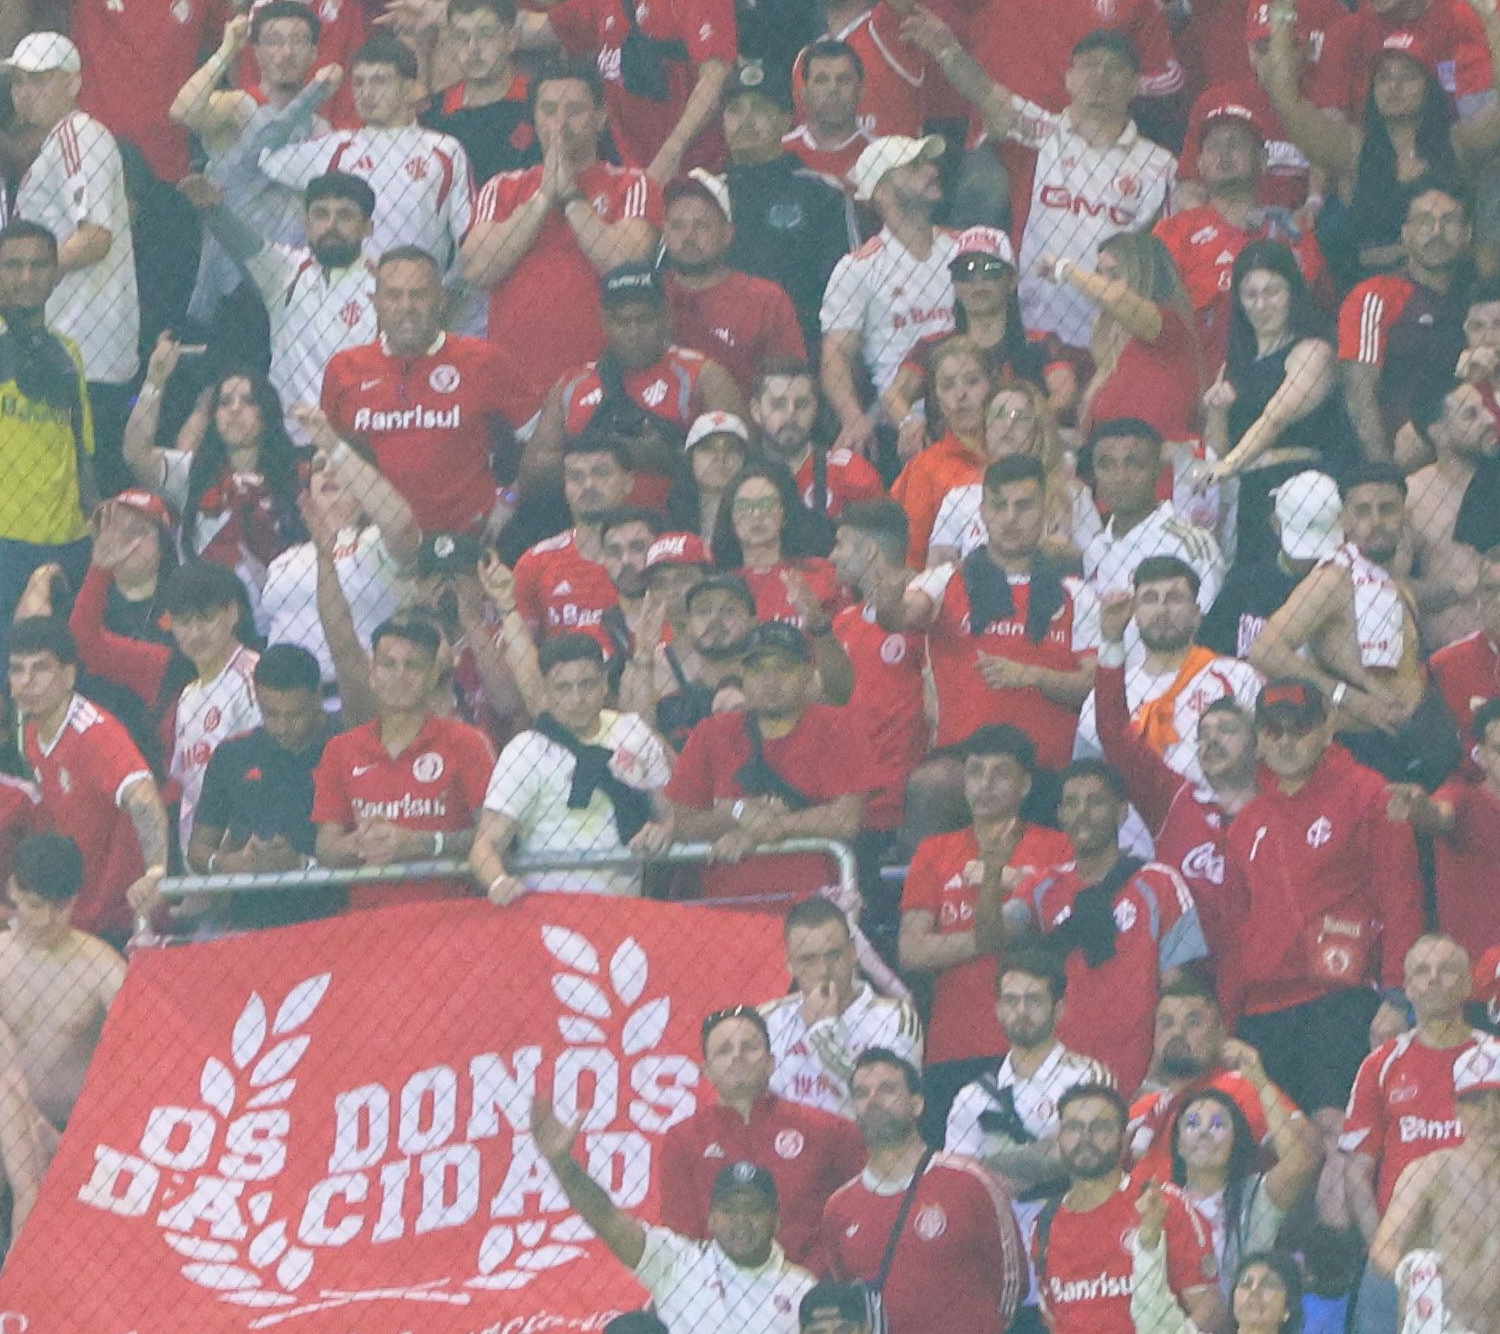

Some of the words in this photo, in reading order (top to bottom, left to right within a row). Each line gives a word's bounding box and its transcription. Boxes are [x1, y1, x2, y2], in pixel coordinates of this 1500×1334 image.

[353, 404, 461, 431] Banrisul
[140, 1104, 291, 1182] OS
[329, 1045, 701, 1175] DONOS
[77, 1143, 249, 1241] DA
[297, 1129, 652, 1248] CIDAD
[1049, 1270, 1134, 1302] Banrisu
